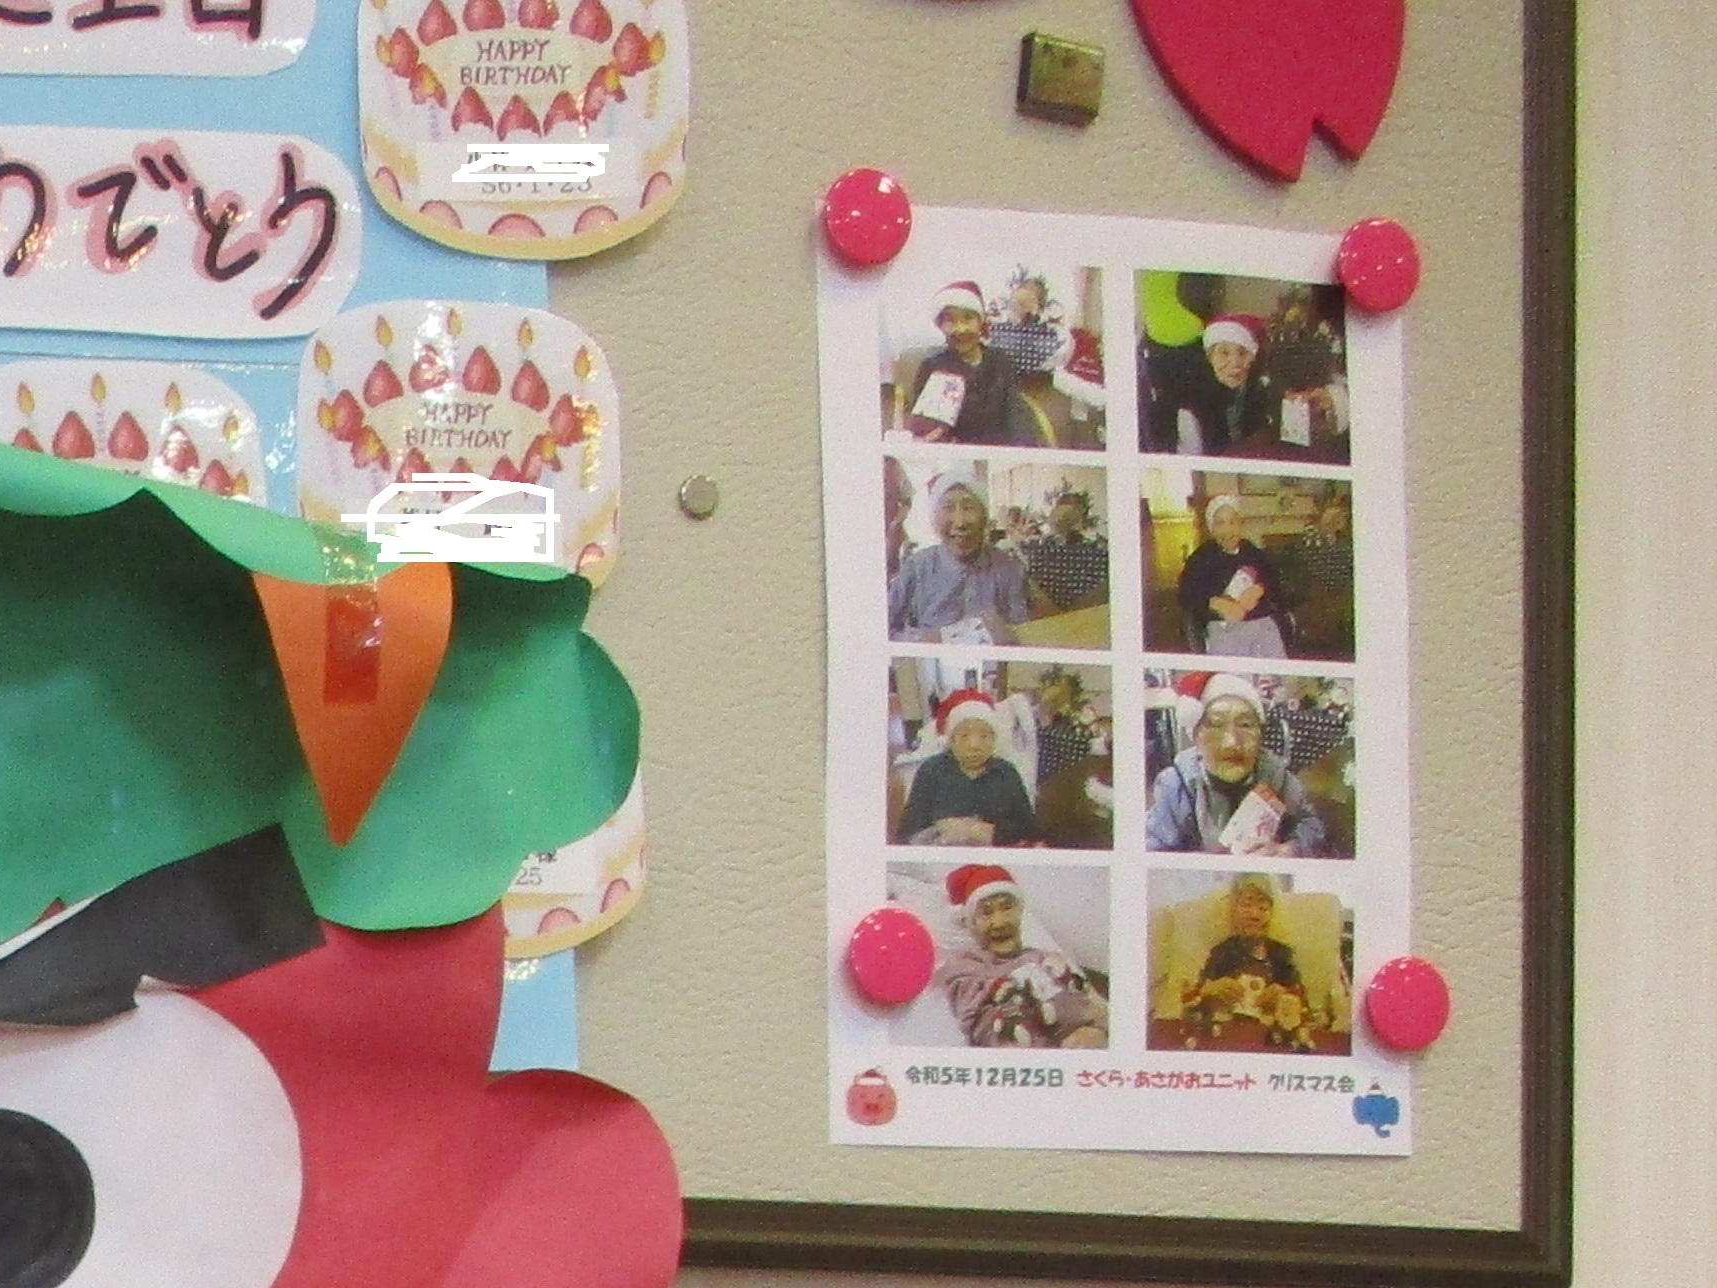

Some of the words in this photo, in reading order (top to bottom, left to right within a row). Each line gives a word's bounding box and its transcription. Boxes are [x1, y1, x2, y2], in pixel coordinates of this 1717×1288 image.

[476, 39, 550, 63] HAPPY
[459, 64, 573, 86] BIRTHDAY
[422, 402, 494, 426] HAPPY
[404, 427, 513, 450] BIRTHDAY
[905, 1065, 1065, 1089] 令和5年12月25日
[1268, 1073, 1356, 1095] クリスマス会
